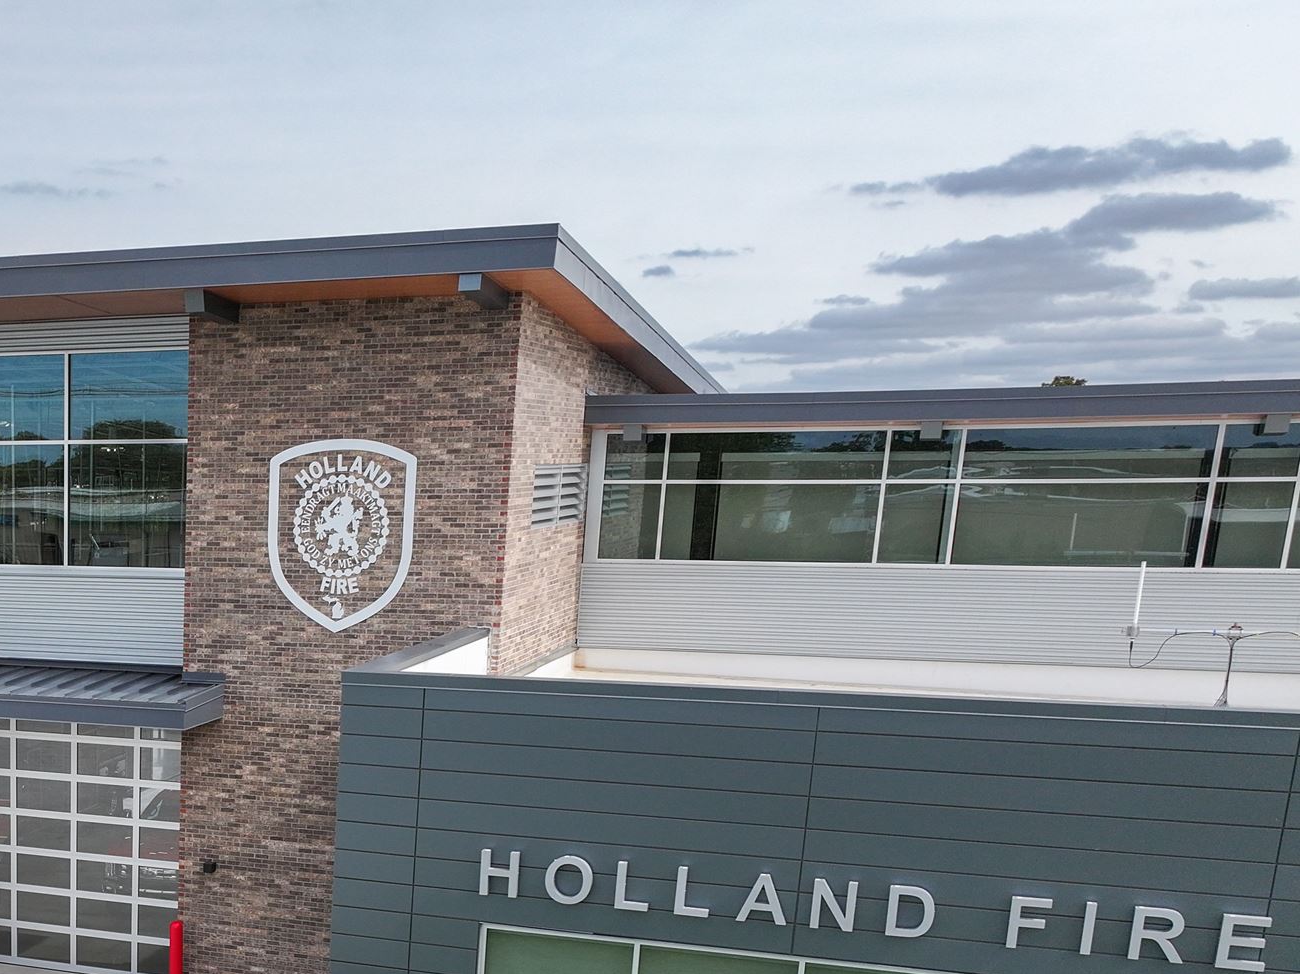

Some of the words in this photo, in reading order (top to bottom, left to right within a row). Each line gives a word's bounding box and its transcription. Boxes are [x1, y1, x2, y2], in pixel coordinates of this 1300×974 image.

[294, 453, 393, 490] HOLLAND
[303, 537, 321, 559] GOD
[319, 555, 335, 568] ZY
[337, 555, 360, 569] MET
[360, 536, 378, 558] ONS
[319, 577, 360, 595] FIRE
[479, 848, 935, 938] HOLLAND
[1005, 895, 1273, 973] FIRE
